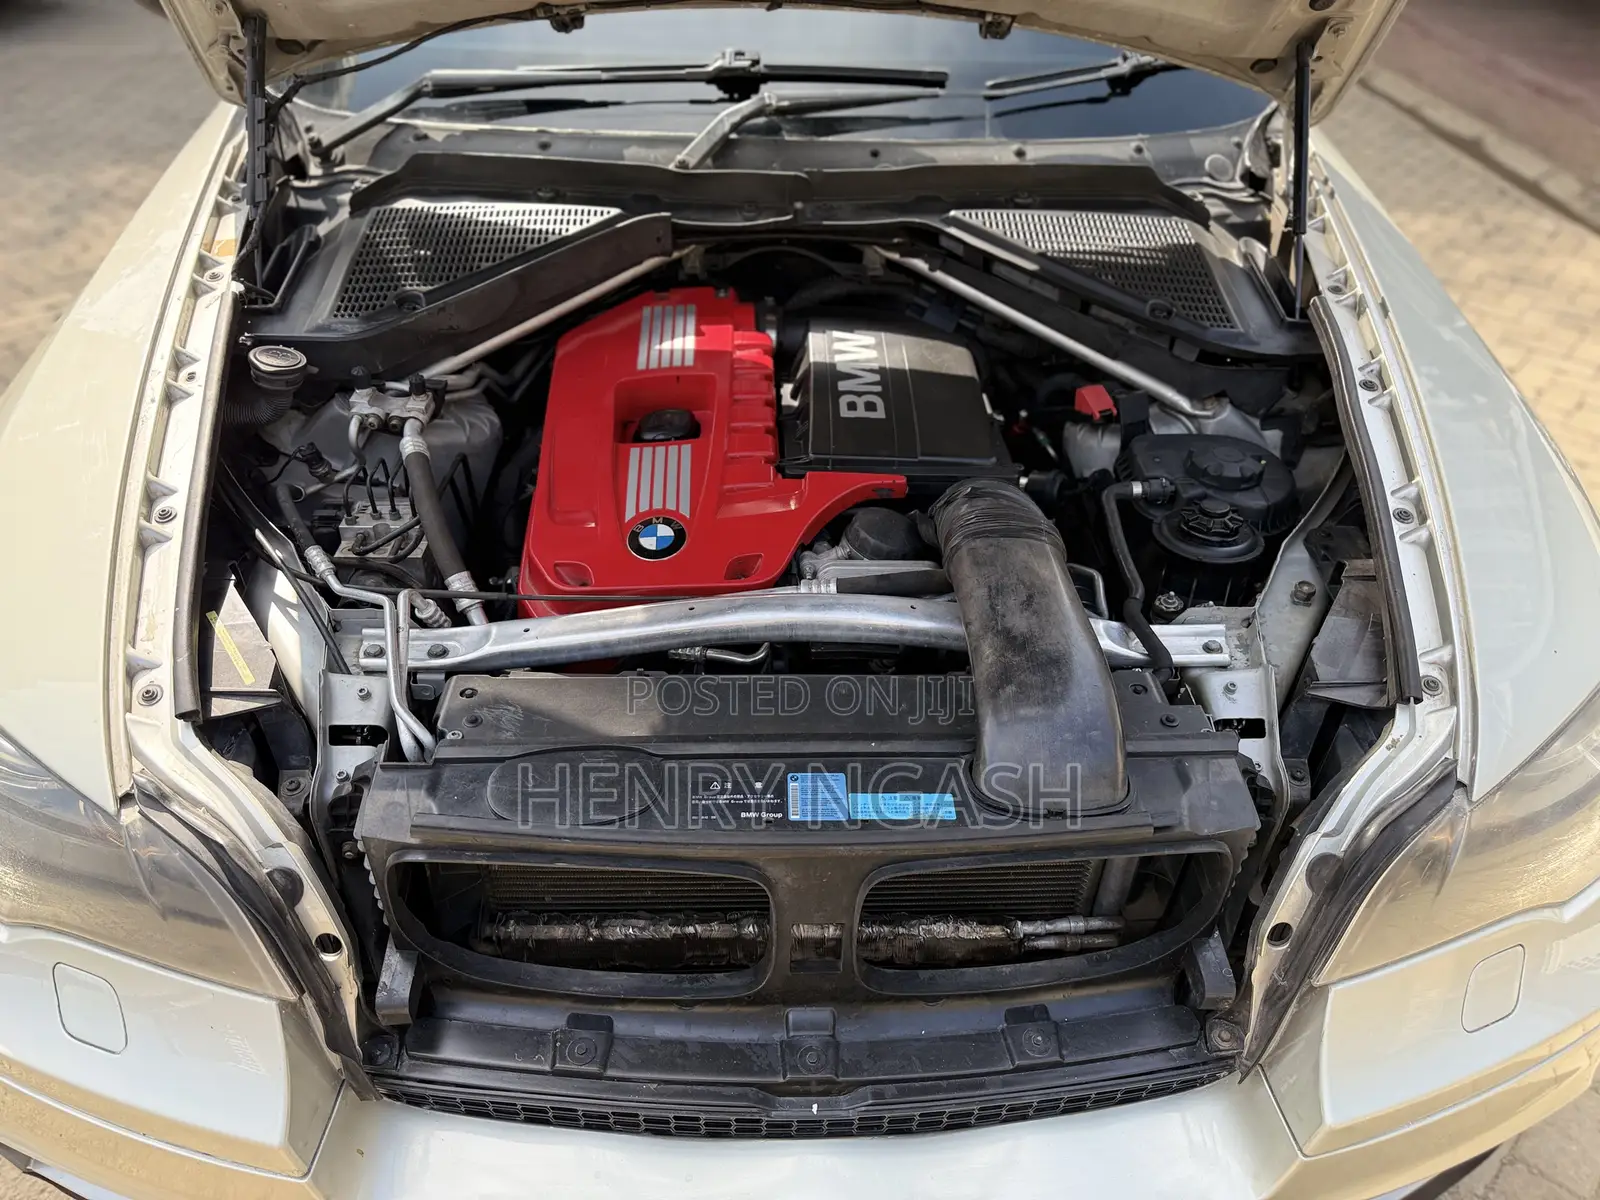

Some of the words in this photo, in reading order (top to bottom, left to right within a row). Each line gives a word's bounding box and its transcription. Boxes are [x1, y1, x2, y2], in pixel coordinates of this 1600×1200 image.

[832, 330, 886, 419] BMW
[632, 517, 682, 532] BMW
[760, 811, 783, 819] Group
